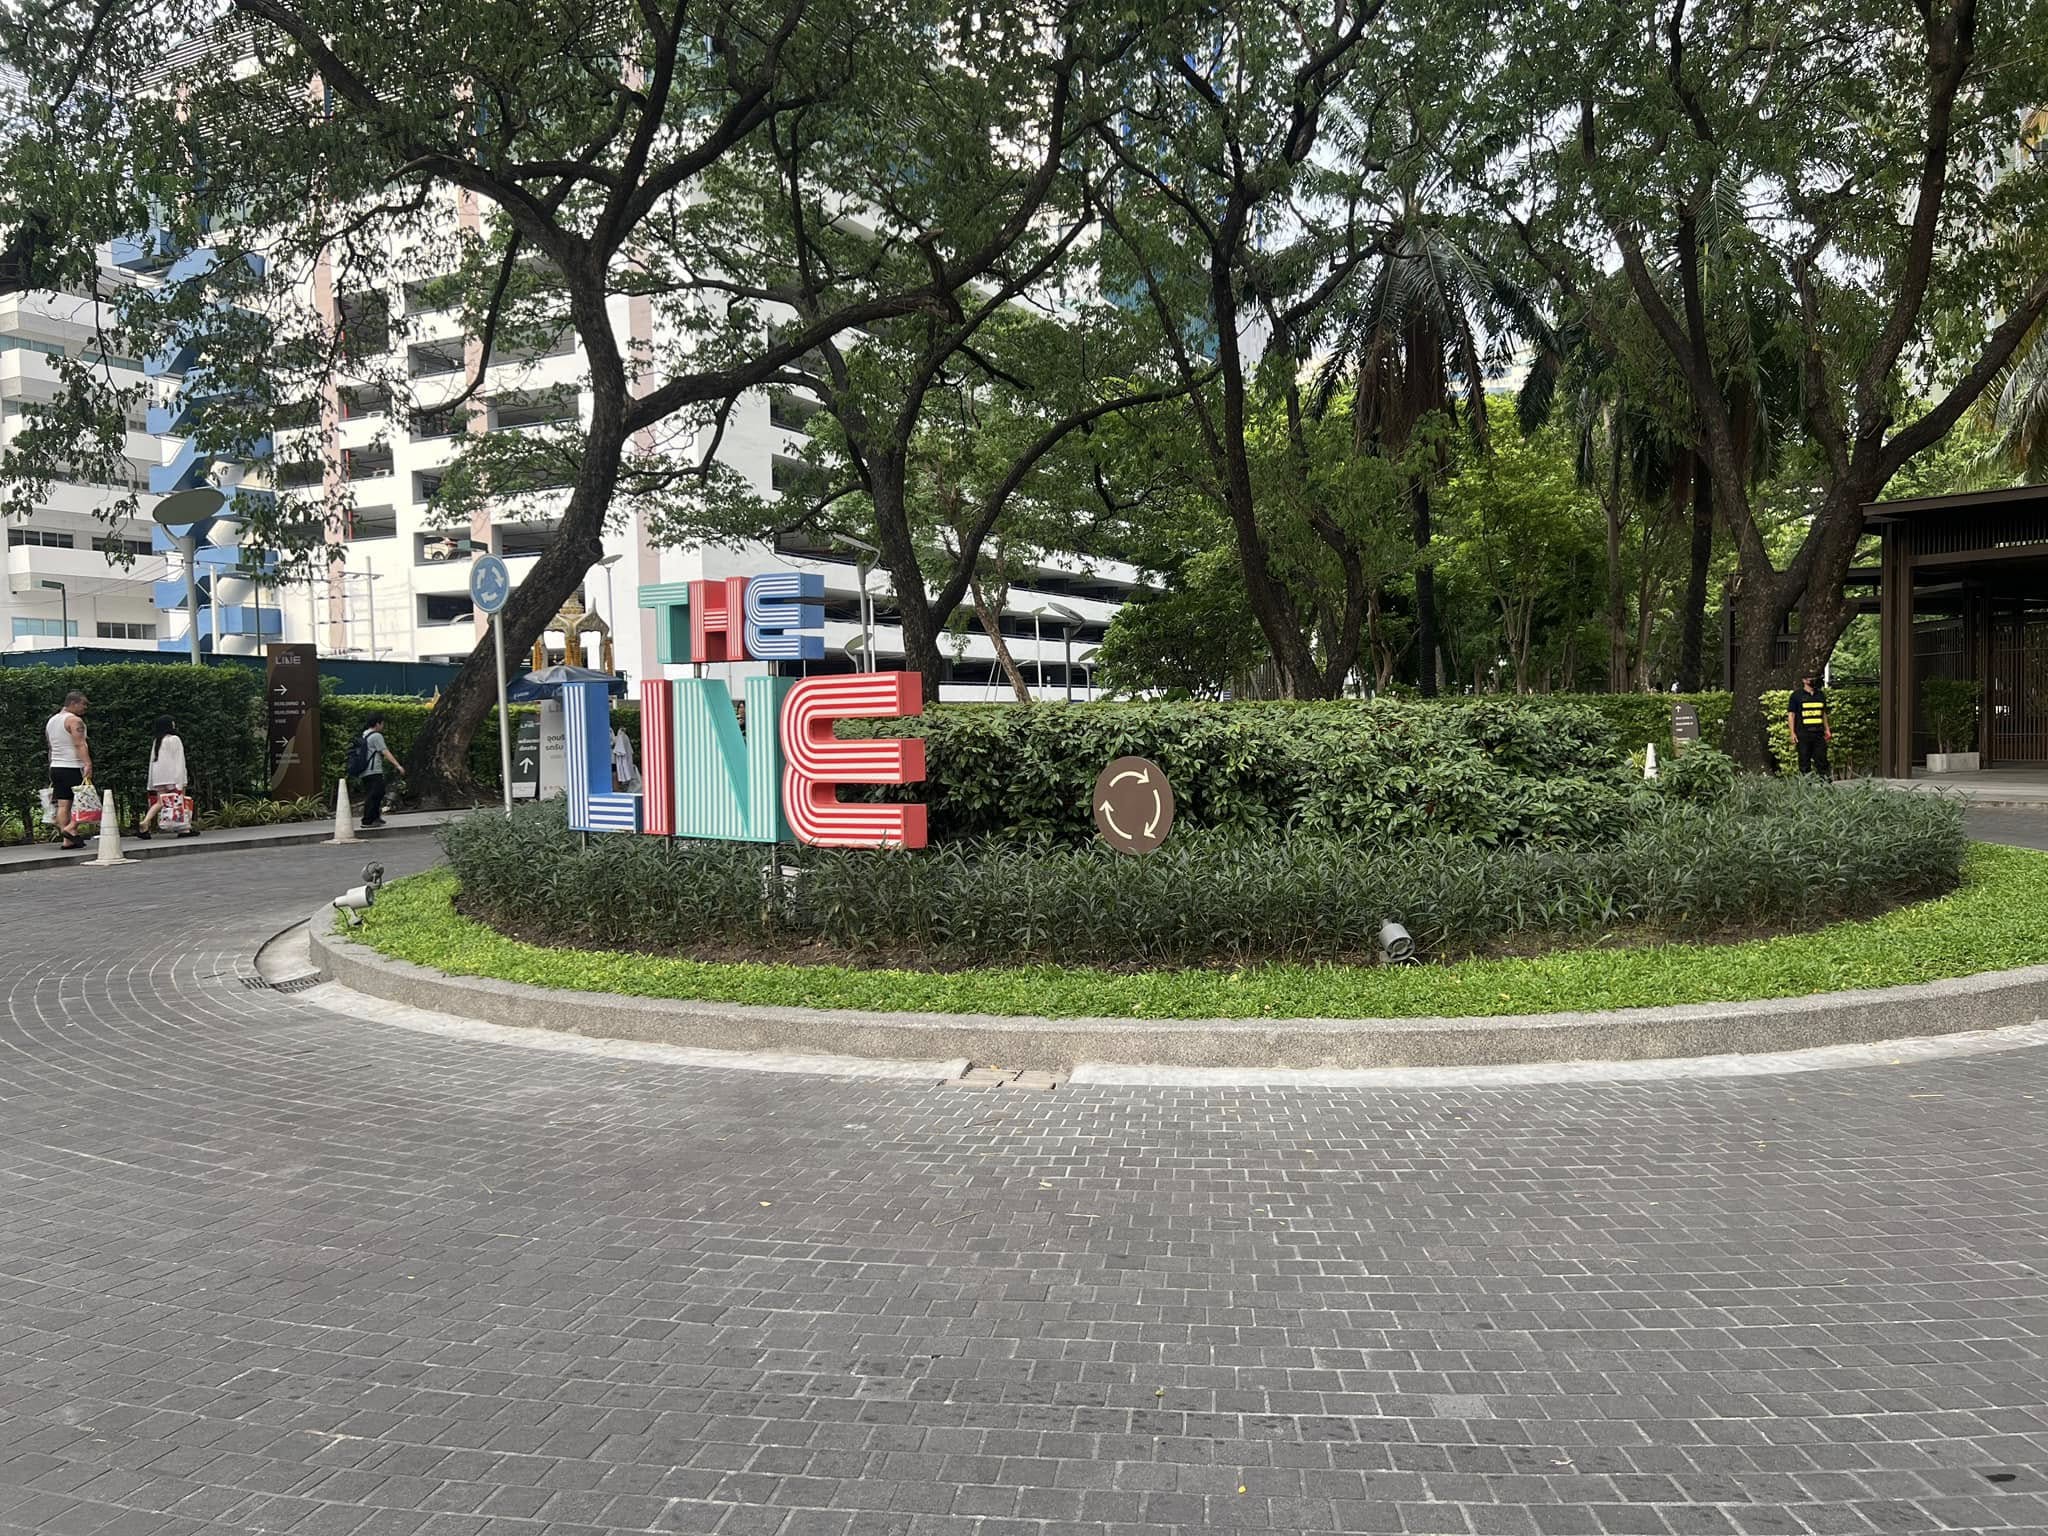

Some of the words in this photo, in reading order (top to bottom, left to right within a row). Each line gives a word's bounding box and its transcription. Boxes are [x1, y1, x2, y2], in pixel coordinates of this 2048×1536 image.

[275, 656, 301, 664] LINE
[638, 572, 825, 664] THE
[562, 670, 928, 849] LINE
